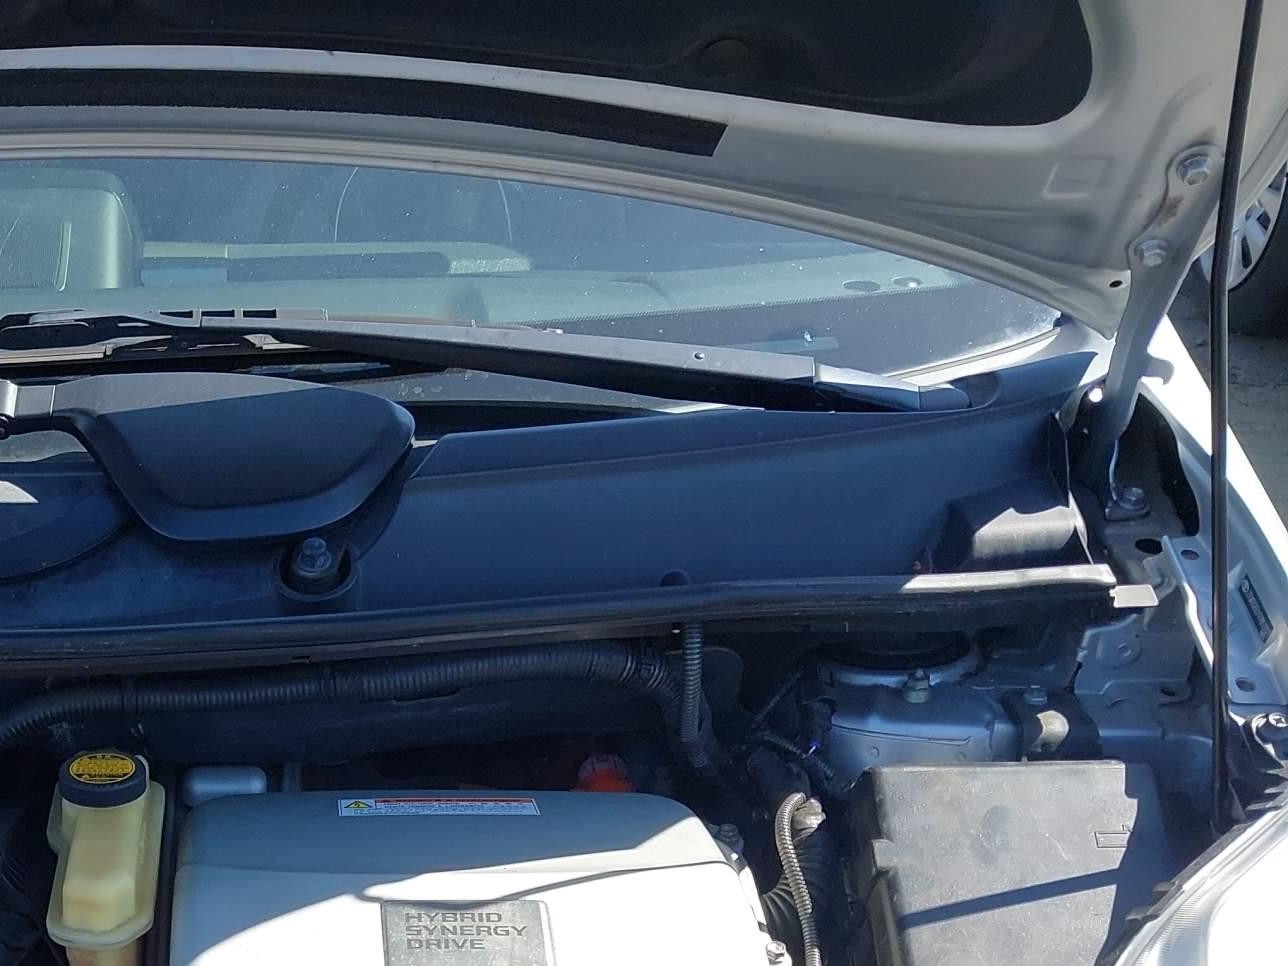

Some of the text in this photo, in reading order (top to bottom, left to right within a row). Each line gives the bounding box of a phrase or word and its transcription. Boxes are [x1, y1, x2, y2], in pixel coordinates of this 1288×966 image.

[405, 912, 502, 923] HYBRID
[405, 925, 527, 936] SYNERGY
[406, 938, 486, 950] DRIVE
